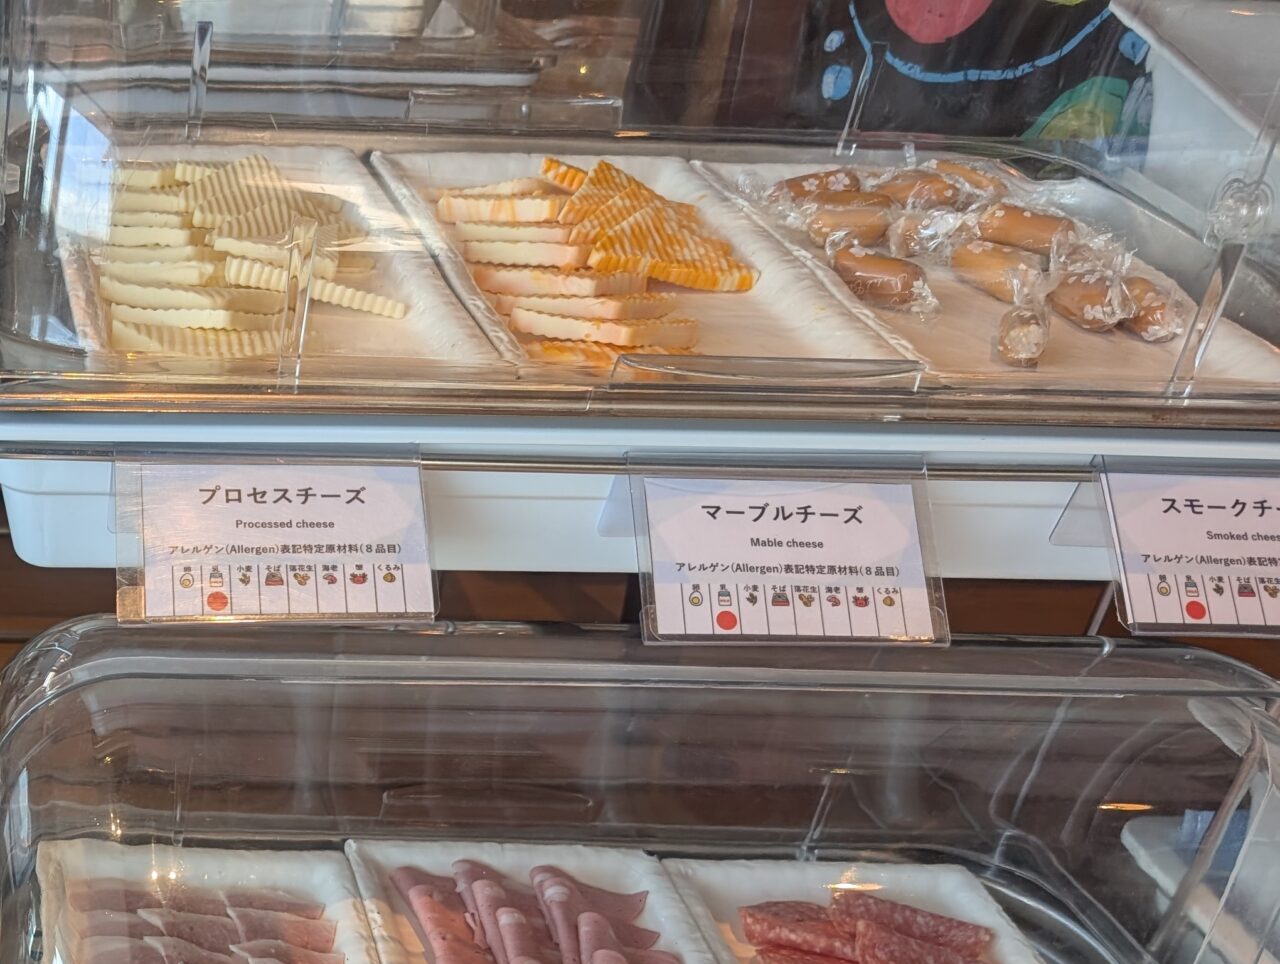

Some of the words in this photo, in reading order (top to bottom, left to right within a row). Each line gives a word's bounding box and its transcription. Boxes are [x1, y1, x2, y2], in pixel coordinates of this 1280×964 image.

[198, 485, 366, 505] プロセスチーズ
[701, 503, 863, 524] マーブルチーズ
[1162, 498, 1280, 517] スモークチ
[236, 520, 293, 529] Processed
[296, 520, 335, 529] cheese
[1206, 531, 1248, 540] Smoked
[750, 538, 783, 548] Mable
[786, 539, 824, 549] cheese
[1141, 554, 1280, 567] アレルゲン(Allergen)表記特
